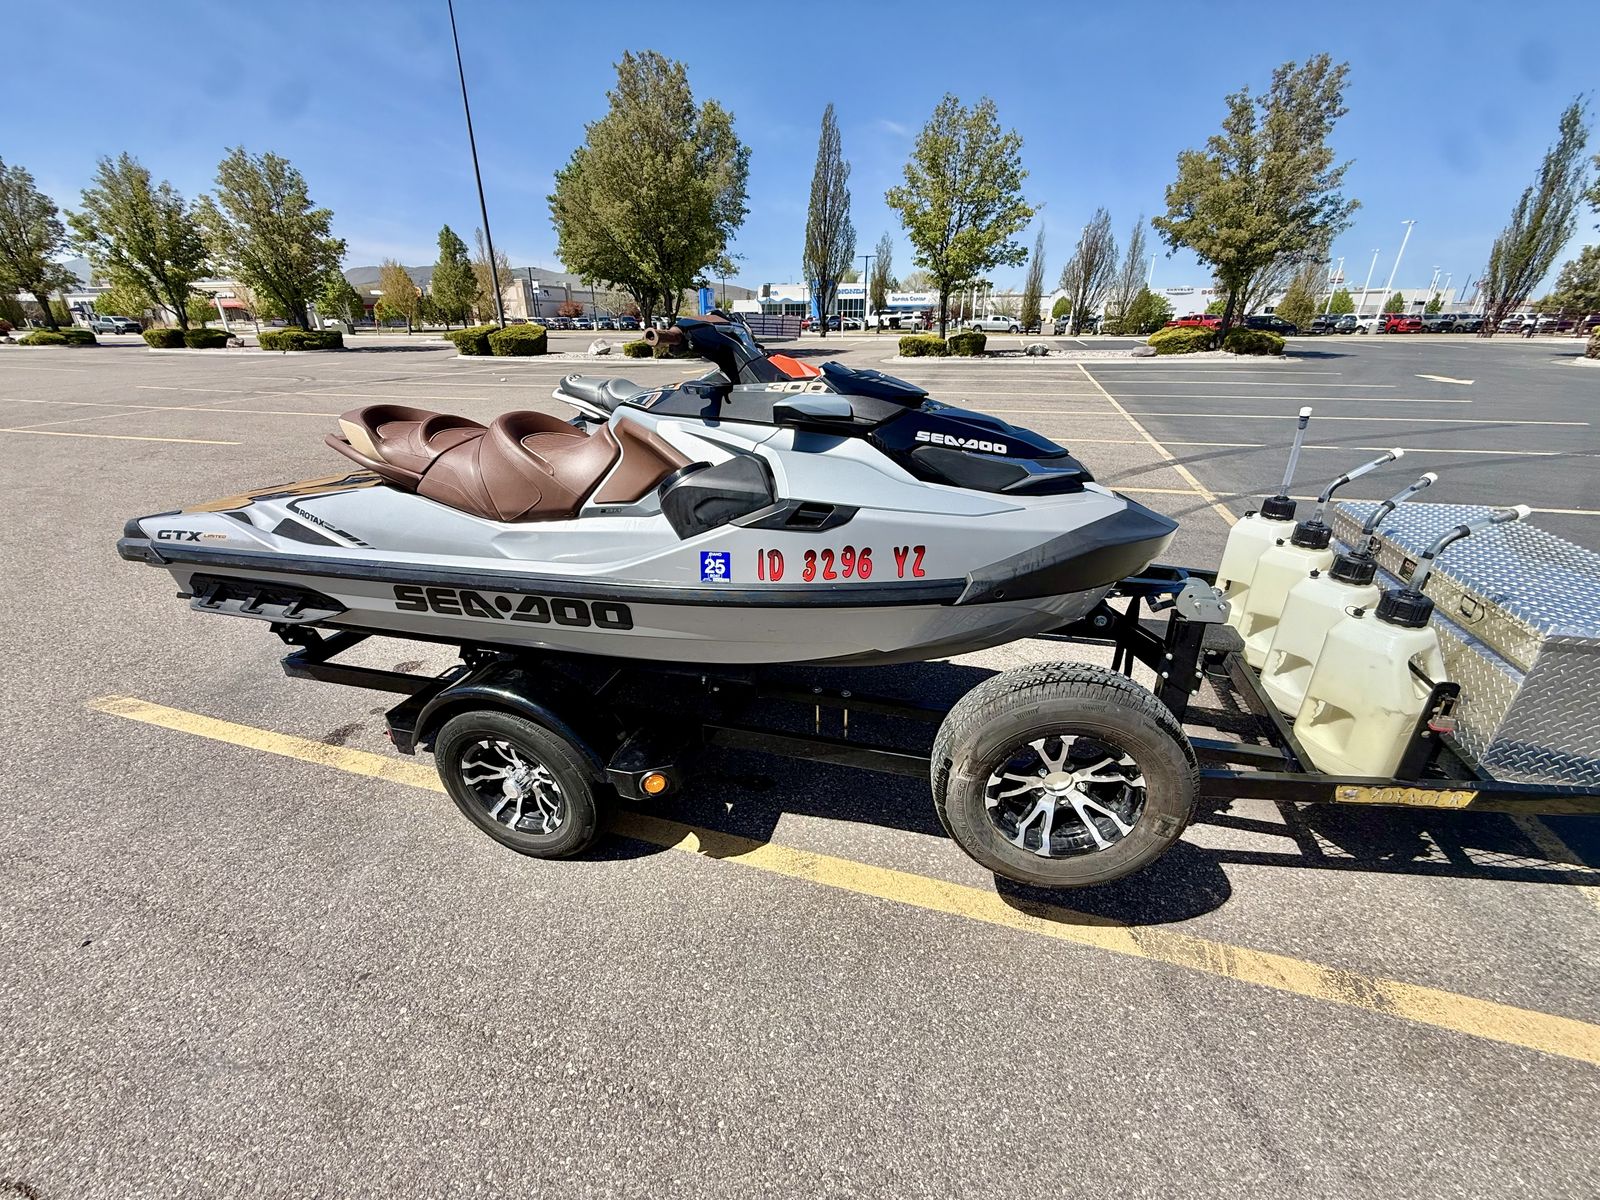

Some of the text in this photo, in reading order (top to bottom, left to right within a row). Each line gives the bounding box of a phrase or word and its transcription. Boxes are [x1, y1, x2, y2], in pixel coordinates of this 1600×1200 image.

[765, 381, 828, 393] 300
[298, 510, 326, 527] ROTAX
[157, 530, 203, 542] GTX
[704, 558, 726, 574] 25
[757, 545, 926, 582] ID 3296 YZ
[1369, 789, 1464, 805] VOYAGER
